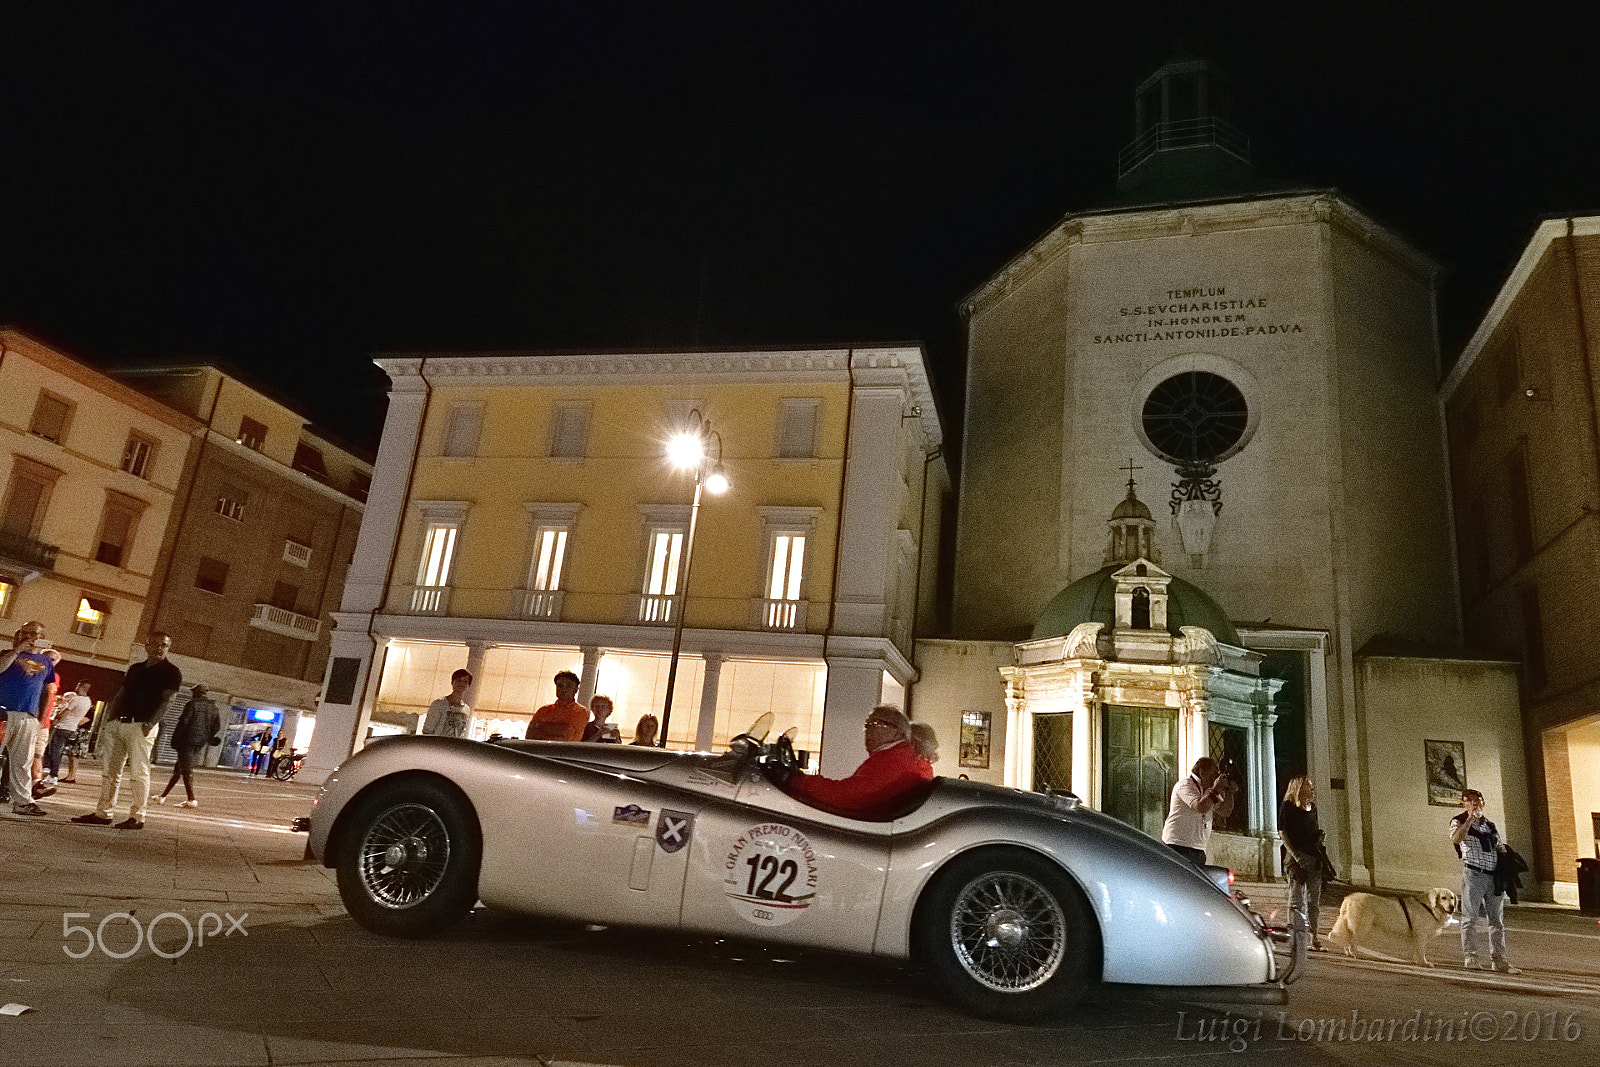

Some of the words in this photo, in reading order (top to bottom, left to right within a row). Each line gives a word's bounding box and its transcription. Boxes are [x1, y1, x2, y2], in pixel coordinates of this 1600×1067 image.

[1166, 287, 1226, 300] TEMPLUM
[726, 836, 748, 870] GRAN
[748, 824, 791, 840] PREMIO
[791, 832, 818, 888] NUVOLARI
[746, 853, 798, 904] 122
